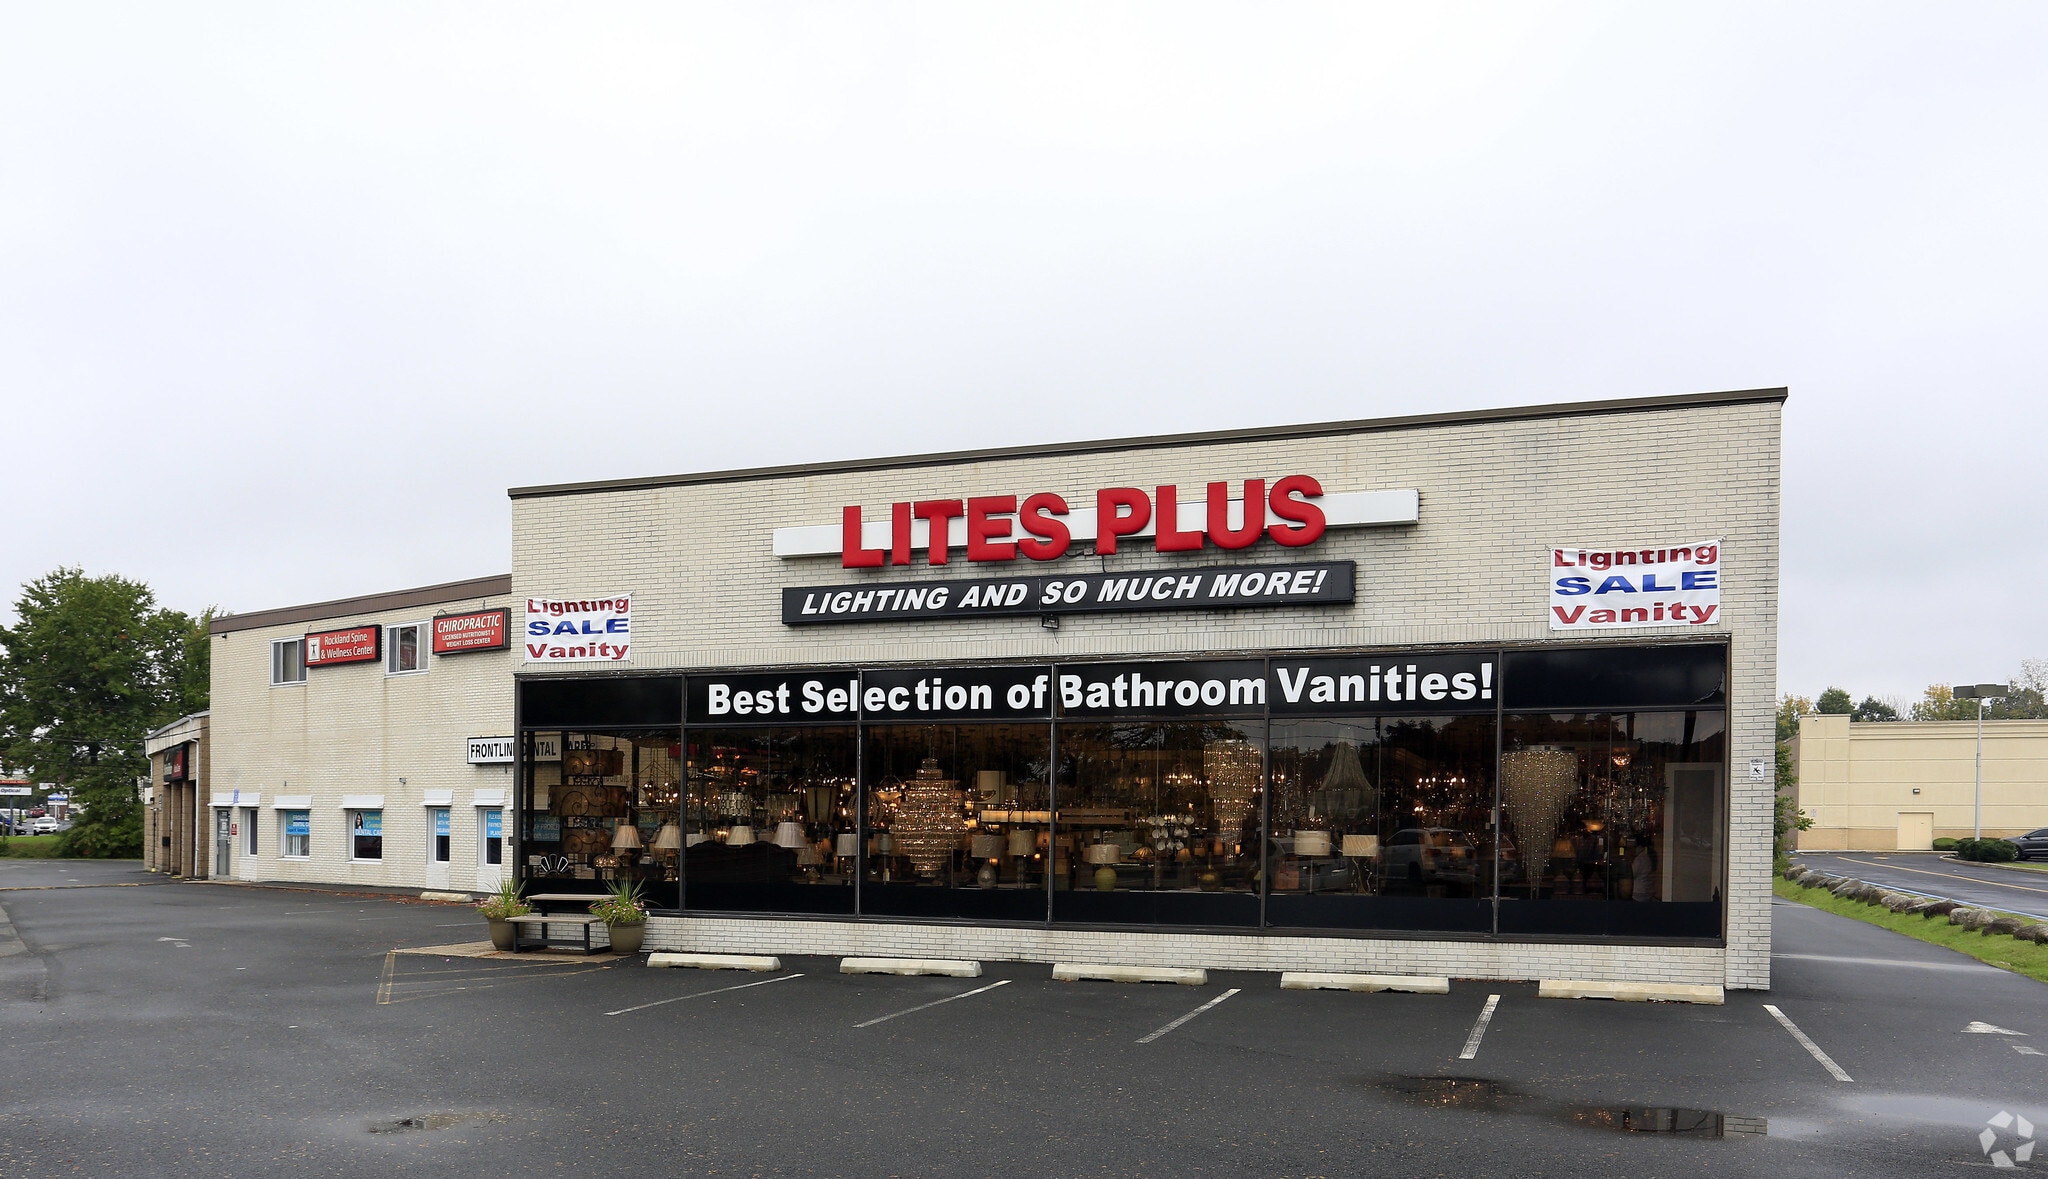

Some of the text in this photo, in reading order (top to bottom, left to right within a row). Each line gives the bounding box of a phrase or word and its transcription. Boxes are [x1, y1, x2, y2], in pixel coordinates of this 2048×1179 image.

[841, 474, 1326, 569] LITES PLUS
[1554, 545, 1718, 571] Lighting
[801, 569, 1328, 615] LIGHTING AND SO MUCH MORE!
[1554, 570, 1718, 596] SALE
[527, 598, 630, 616] Lighting
[1552, 601, 1719, 624] Vanity
[437, 614, 501, 633] CHIROPRACTIC
[527, 618, 629, 636] SALE
[324, 632, 368, 646] Rockland Spine
[441, 632, 462, 641] LICENSED
[462, 630, 490, 638] NUTRITIONIST
[445, 640, 462, 648] WEIGHT
[473, 637, 491, 645] CENTER
[320, 646, 374, 660] & Wellness Center
[526, 642, 630, 660] Vanity
[708, 662, 1494, 715] Best Selection of Bathroom Vanities!
[470, 741, 514, 758] FRONTLIN
